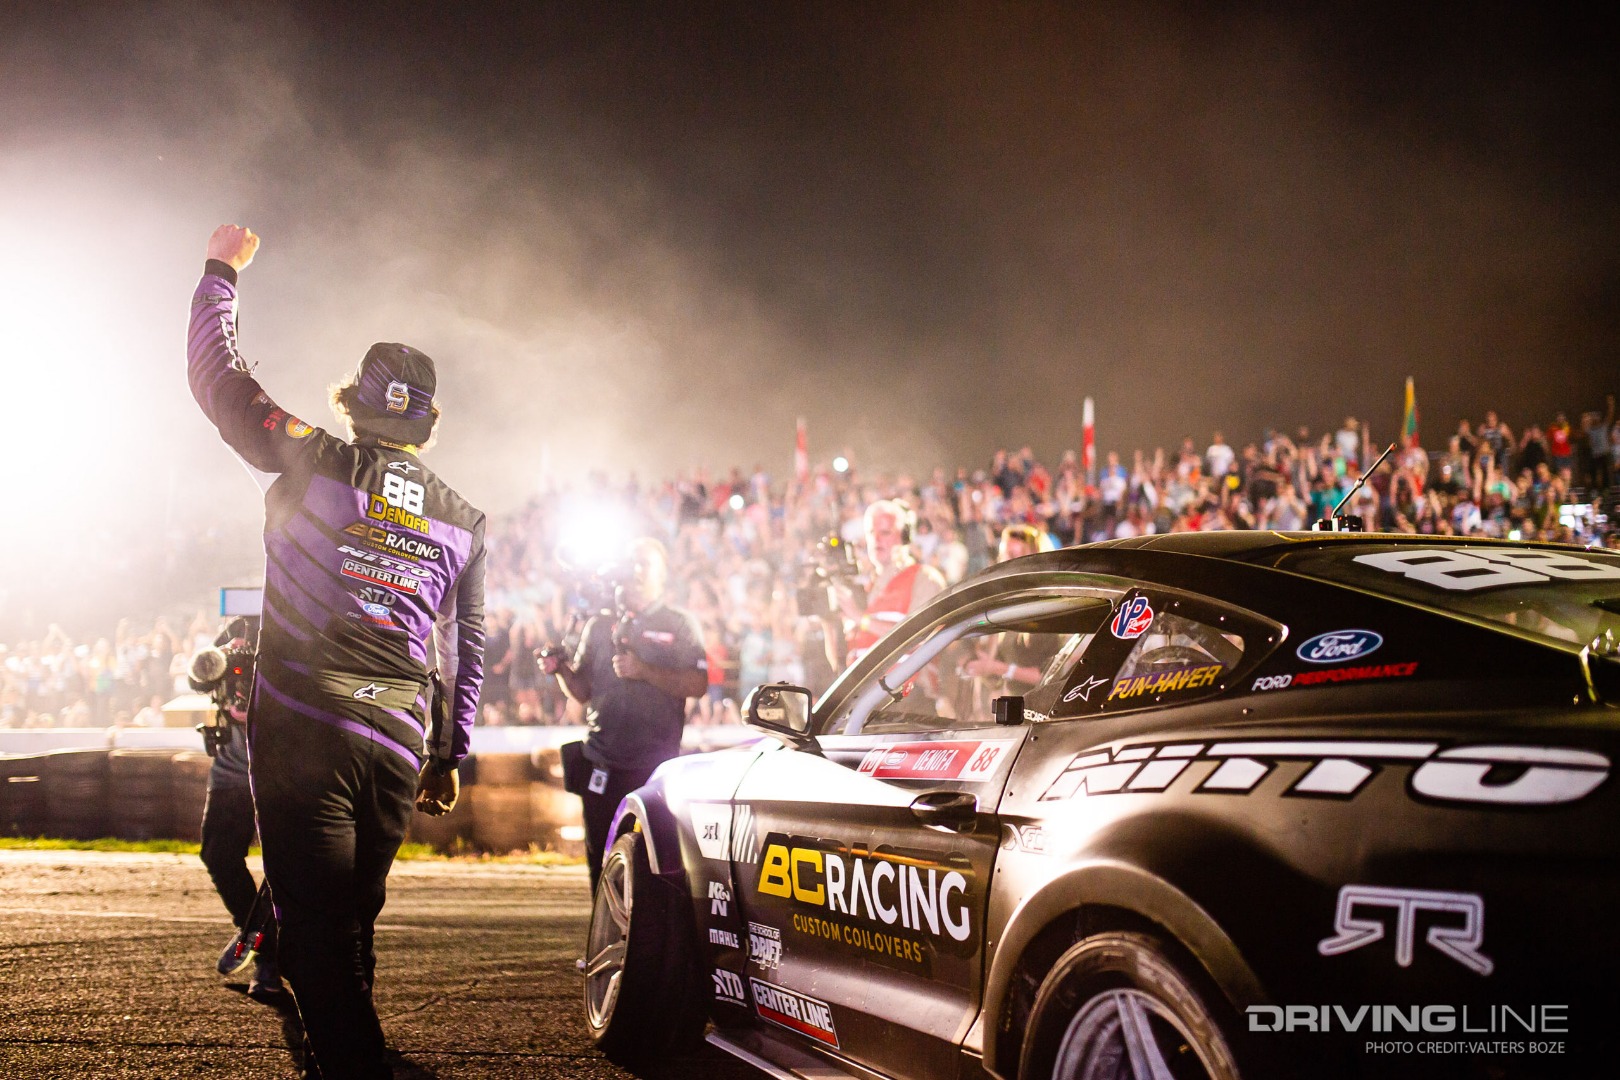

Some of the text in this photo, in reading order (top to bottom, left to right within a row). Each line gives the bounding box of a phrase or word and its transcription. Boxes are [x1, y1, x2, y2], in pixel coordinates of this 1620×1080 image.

[382, 472, 425, 516] 88
[337, 545, 432, 578] NITTO
[362, 540, 387, 553] CUSTOM
[344, 560, 418, 591] CENTER LINE
[1352, 549, 1620, 591] 88
[1116, 597, 1149, 637] VP
[1310, 634, 1368, 659] Ford
[1107, 665, 1223, 701] FUN-HAVER
[1251, 661, 1419, 692] FORD PERFORMANCE
[970, 747, 1000, 773] 88
[1037, 741, 1610, 804] NITTO
[709, 928, 739, 949] MAHLE
[750, 933, 781, 963] DRIFT
[793, 912, 923, 963] CUSTOM COILOVERS
[752, 982, 834, 1034] CENTER LINE
